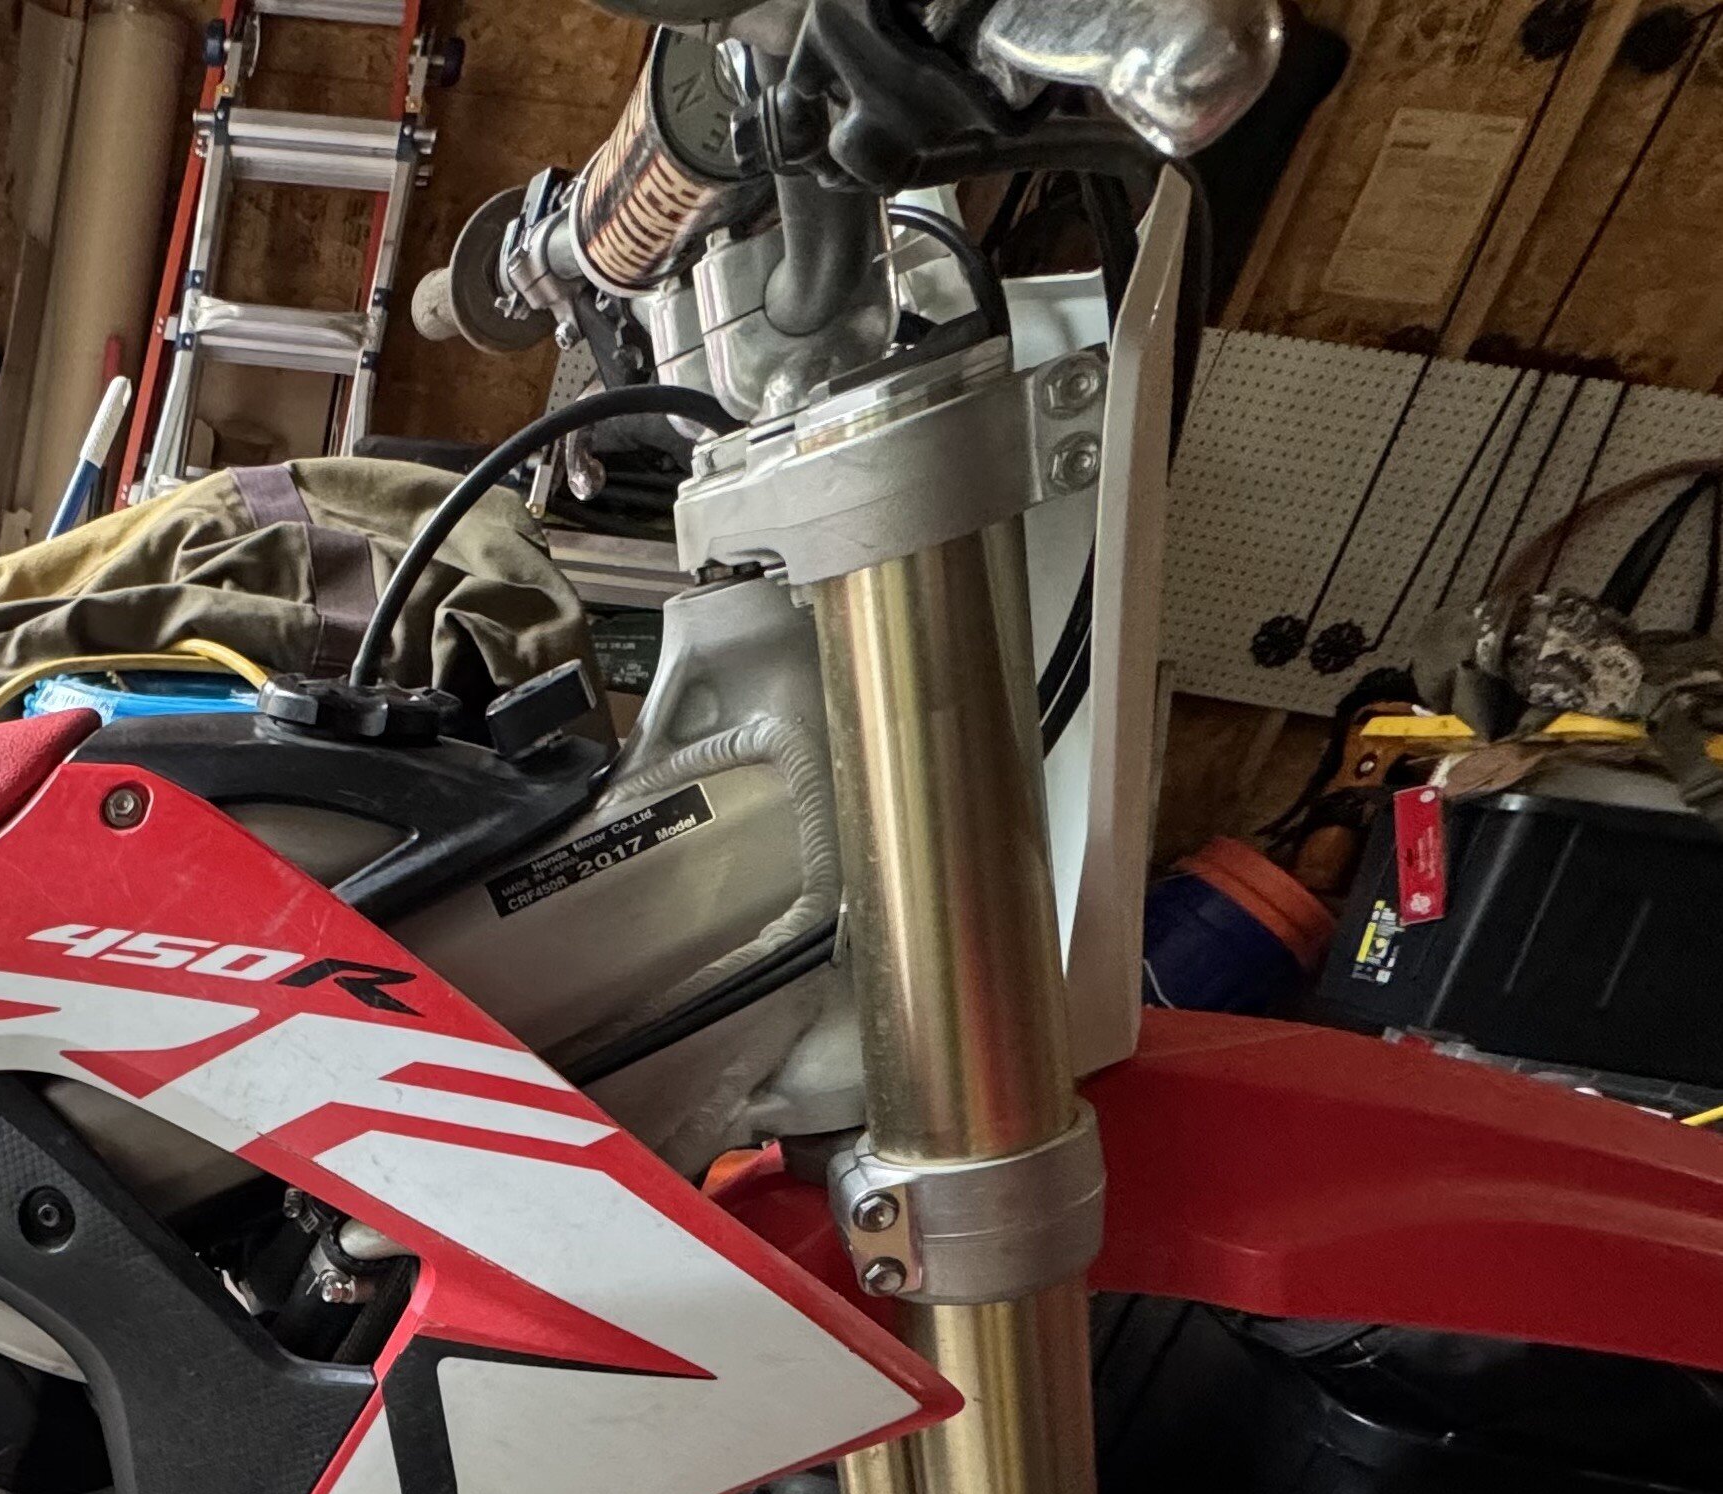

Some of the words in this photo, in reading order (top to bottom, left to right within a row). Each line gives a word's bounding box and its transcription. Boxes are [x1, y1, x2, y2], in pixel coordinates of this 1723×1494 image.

[572, 831, 607, 854] Motor
[578, 835, 643, 880] 2017
[654, 813, 697, 843] Model
[26, 923, 426, 1018] 450R
